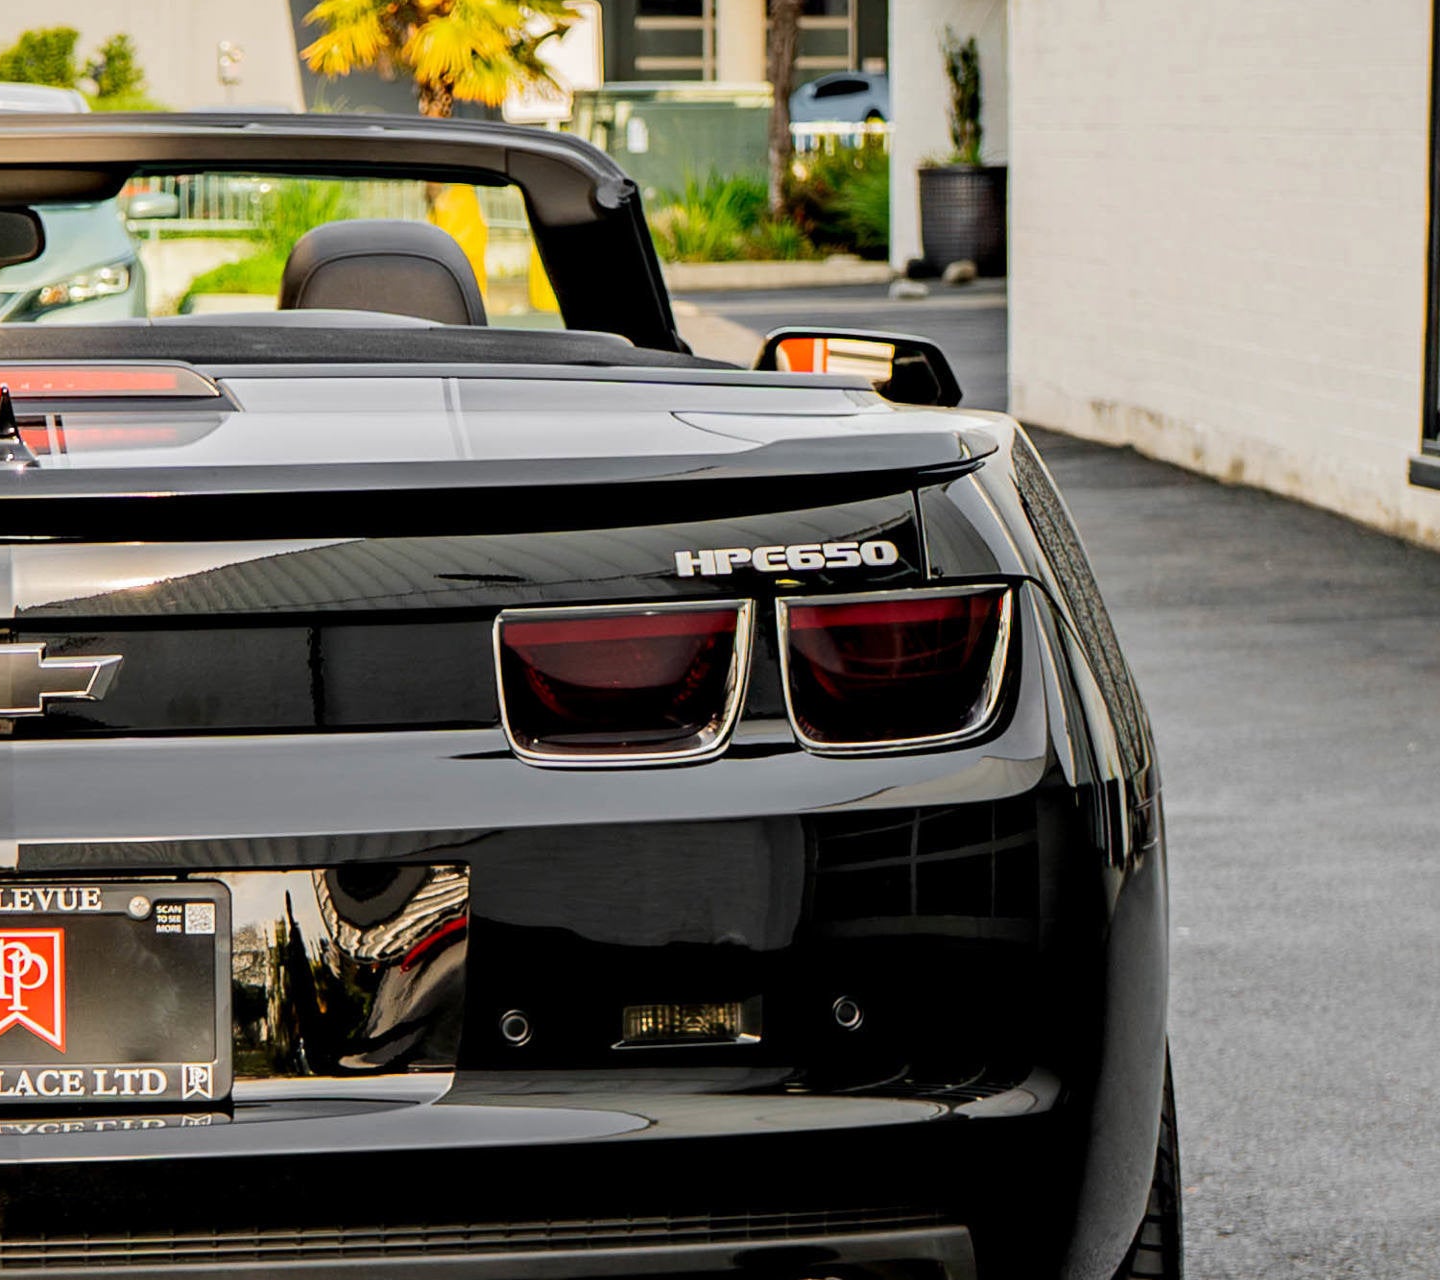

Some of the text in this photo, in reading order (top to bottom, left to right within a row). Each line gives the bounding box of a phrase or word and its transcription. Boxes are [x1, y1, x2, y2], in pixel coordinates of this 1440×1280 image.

[675, 540, 899, 577] HPE650
[155, 904, 183, 914] SCAN
[156, 914, 168, 923] TO
[156, 924, 182, 934] MORE
[92, 1068, 168, 1096] LTD
